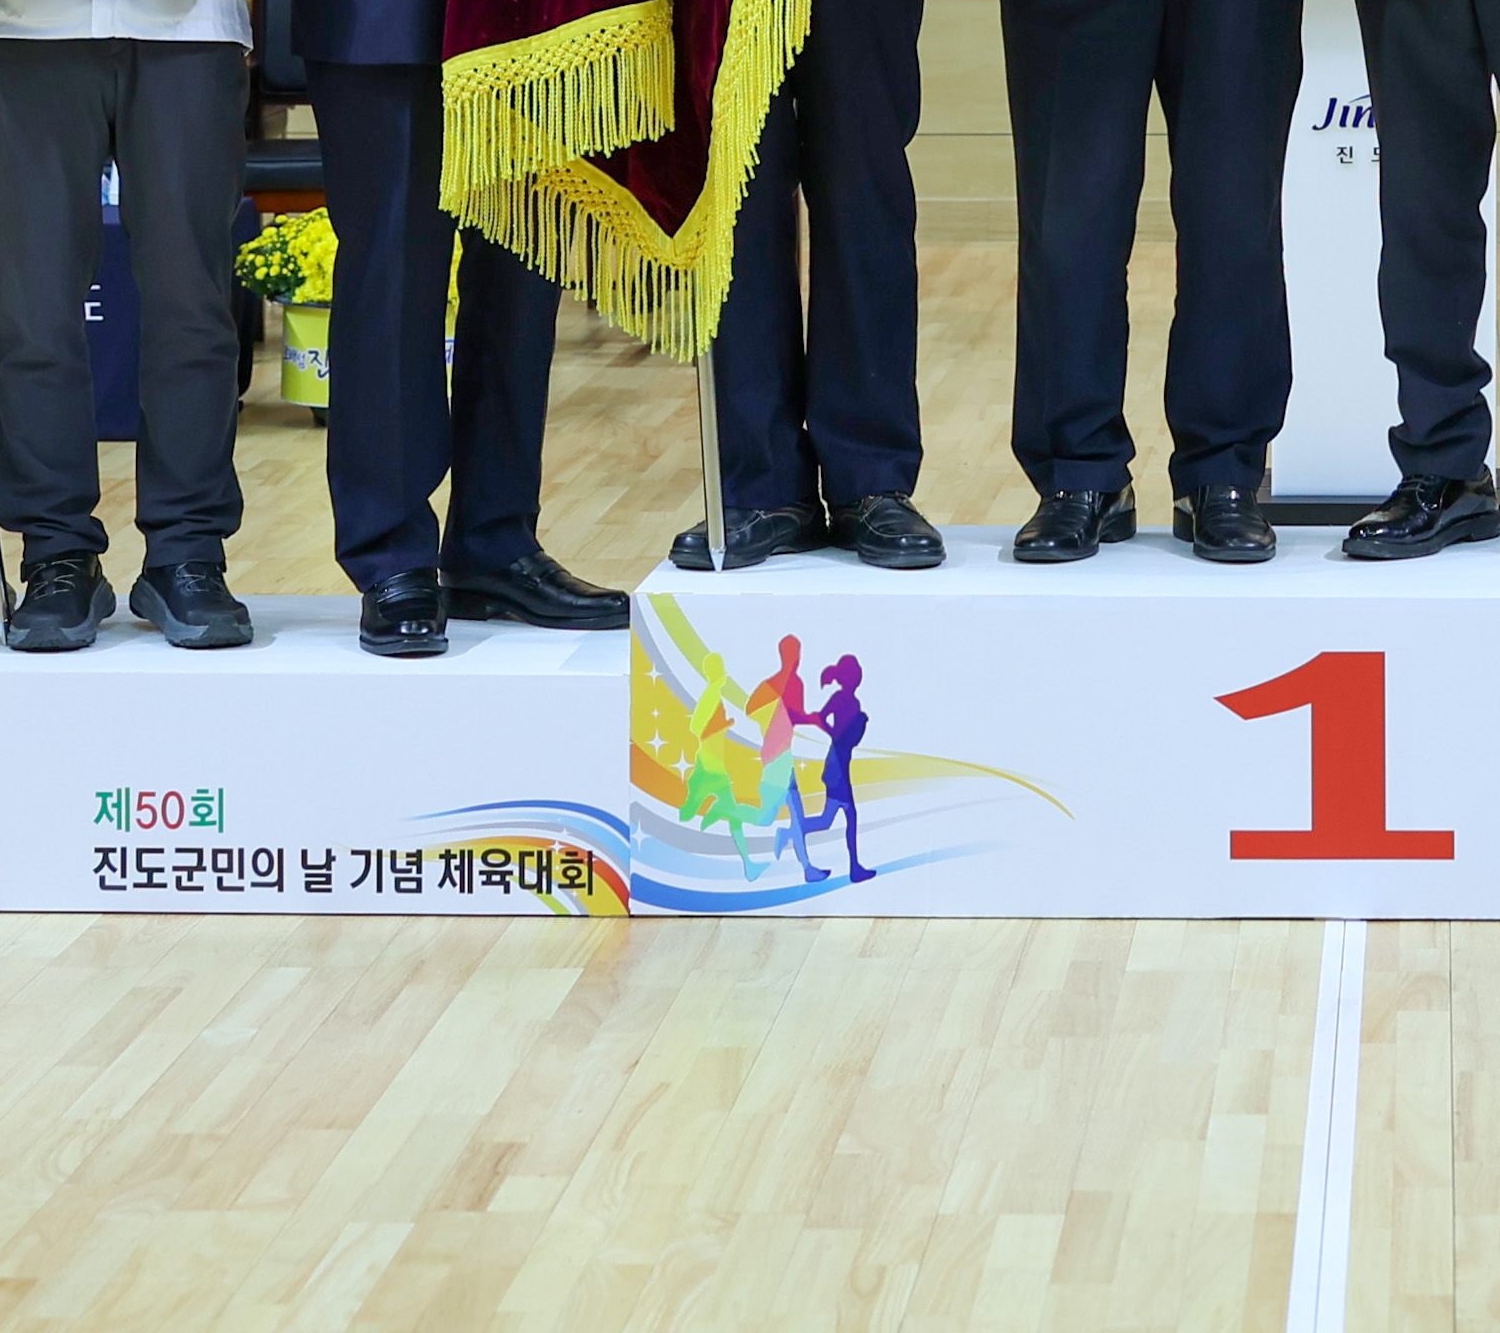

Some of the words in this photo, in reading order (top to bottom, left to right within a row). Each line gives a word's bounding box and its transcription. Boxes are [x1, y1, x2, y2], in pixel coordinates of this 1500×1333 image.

[1213, 652, 1455, 860] 1
[93, 787, 226, 833] 제50회
[93, 847, 285, 894] 진도군민의
[300, 846, 336, 893] 날
[349, 848, 423, 894] 기념
[437, 848, 595, 895] 체육대회
